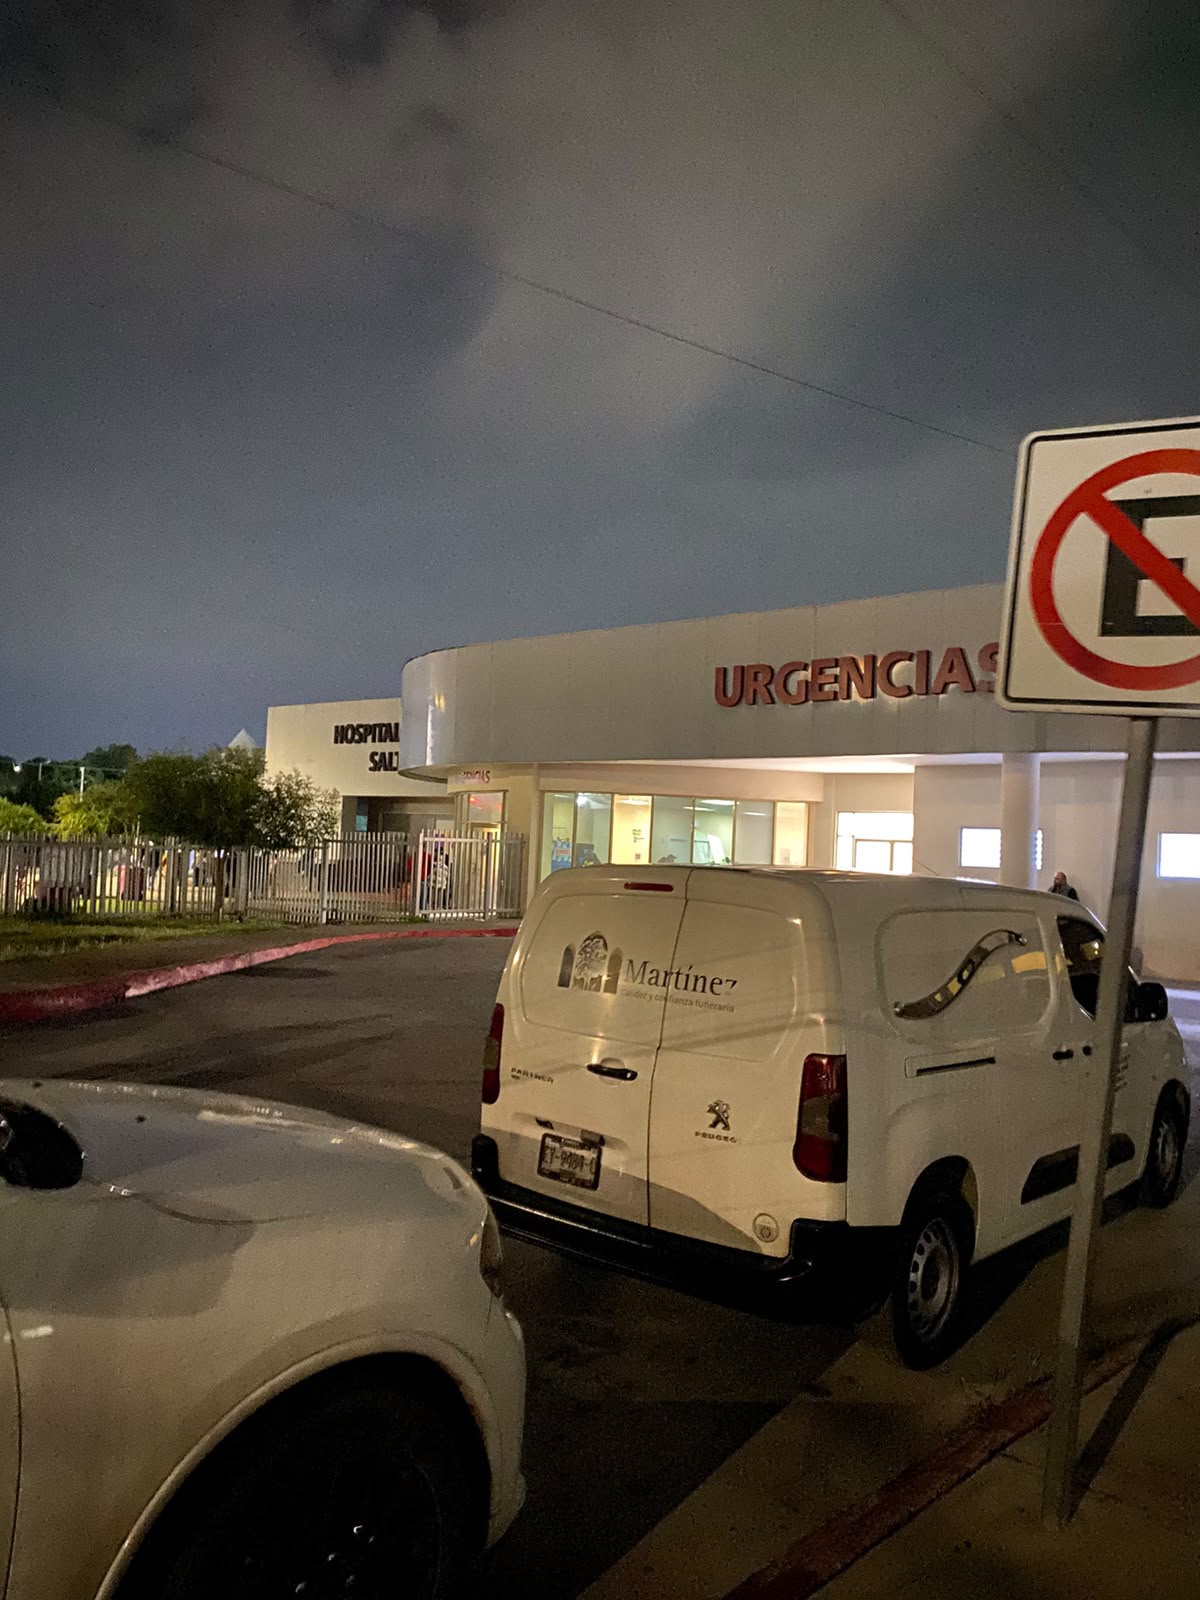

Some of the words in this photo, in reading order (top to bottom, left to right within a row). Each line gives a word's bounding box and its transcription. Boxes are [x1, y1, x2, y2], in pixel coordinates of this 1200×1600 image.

[714, 642, 1000, 708] URGENCIAS
[333, 721, 400, 745] HOSPITAL
[626, 959, 738, 996] Martínez
[654, 992, 694, 1006] cofianza
